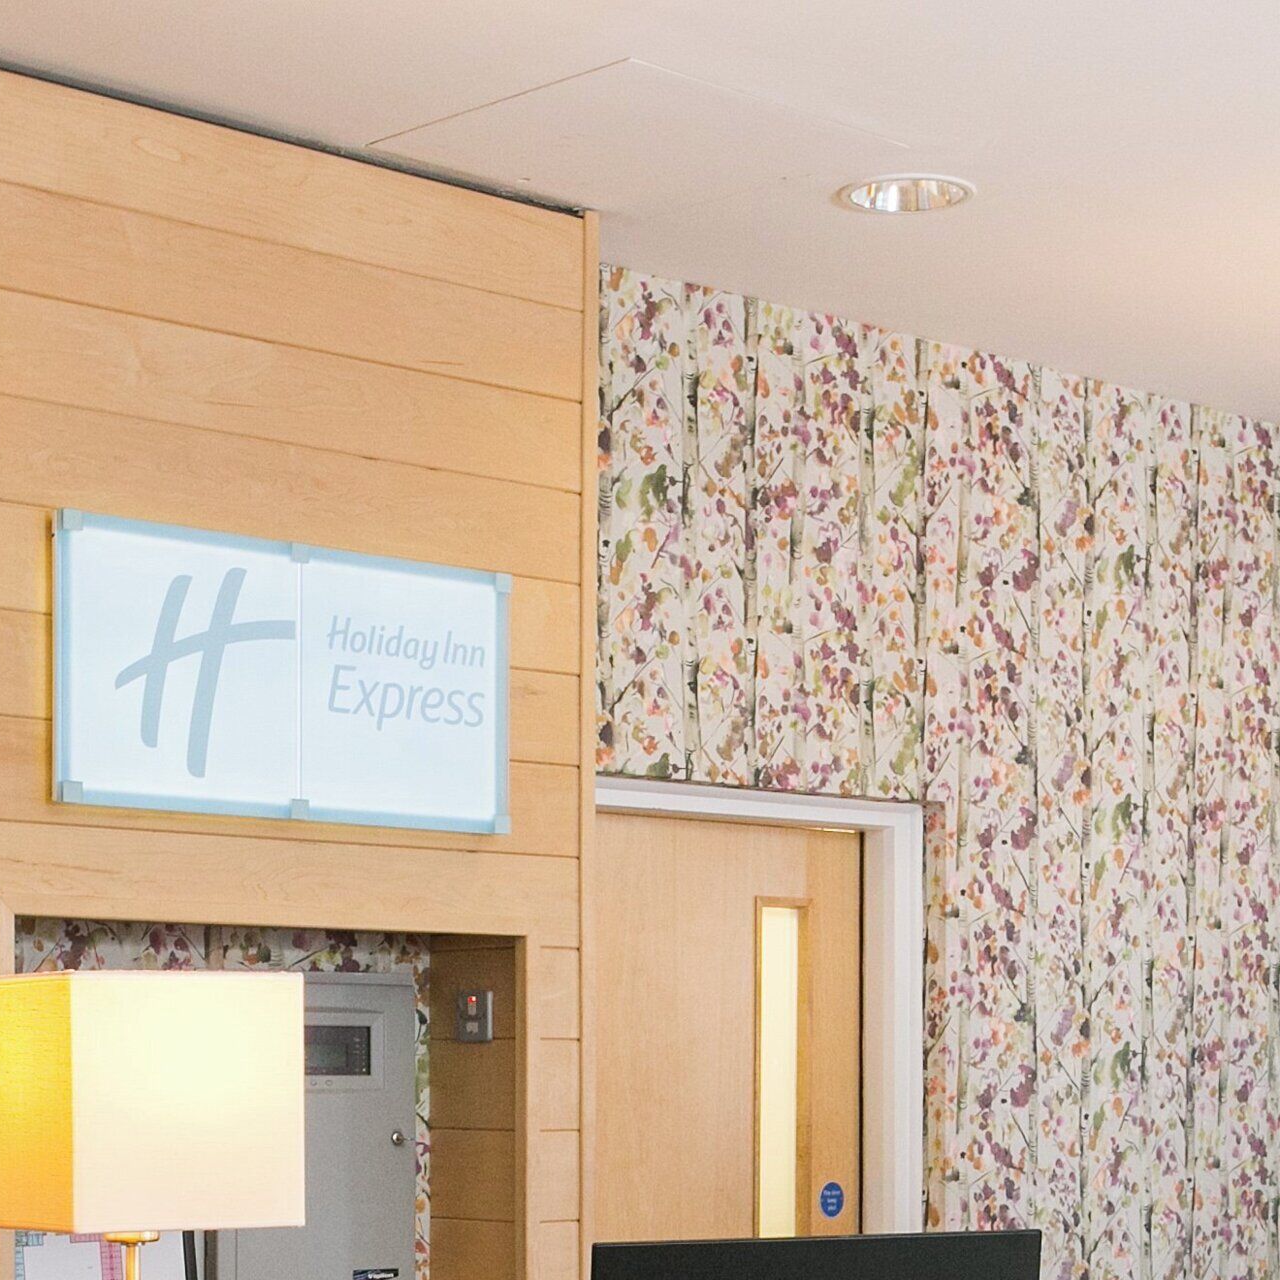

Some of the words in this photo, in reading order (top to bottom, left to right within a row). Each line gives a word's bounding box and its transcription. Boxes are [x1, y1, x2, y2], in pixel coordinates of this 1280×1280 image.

[326, 615, 438, 670] Holiday
[443, 630, 485, 669] Inn
[327, 665, 485, 730] Express
